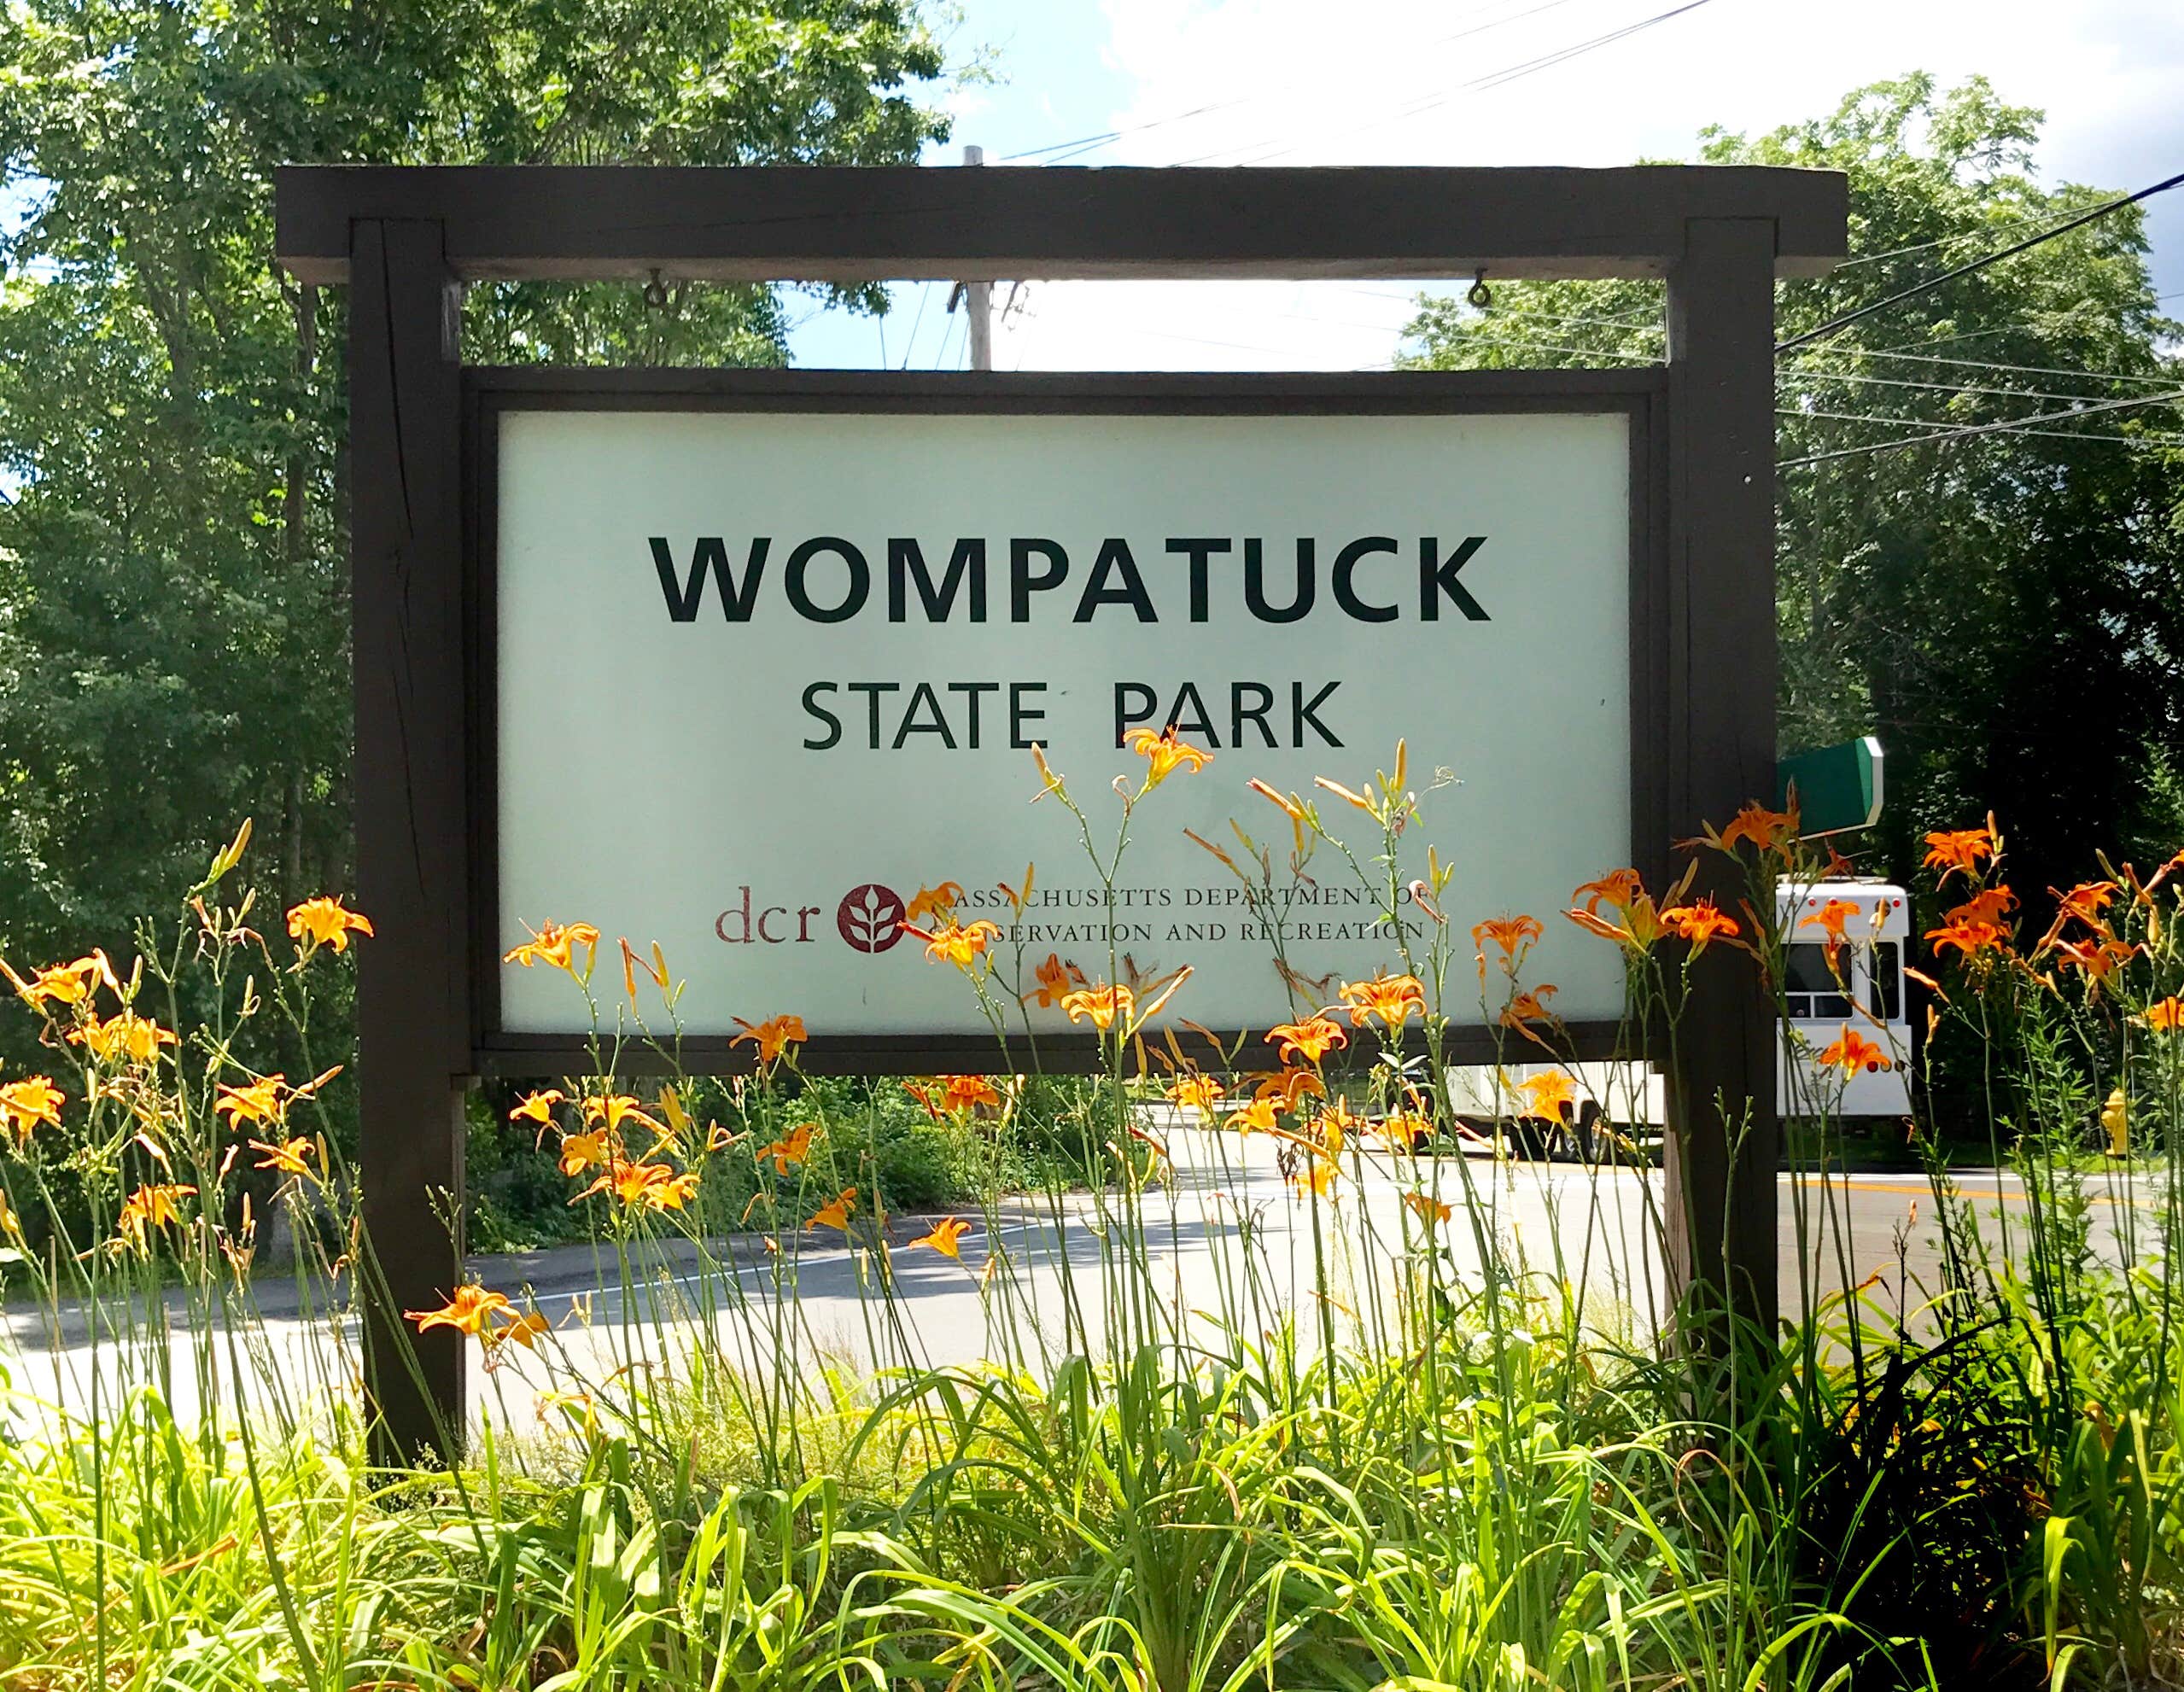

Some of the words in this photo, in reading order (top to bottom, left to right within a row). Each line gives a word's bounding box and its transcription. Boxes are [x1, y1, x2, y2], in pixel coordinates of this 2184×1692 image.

[649, 536, 1491, 624] WOMPATUCK
[802, 681, 1048, 750] STATE
[1114, 681, 1345, 749] PARK
[715, 886, 821, 944] dcr
[931, 889, 1171, 907] ASSCHUSETTS
[1185, 888, 1381, 906] DEPARTMENT
[929, 923, 1152, 942] SERVATION
[1165, 924, 1226, 941] AND
[1241, 921, 1423, 940] RECREATION
